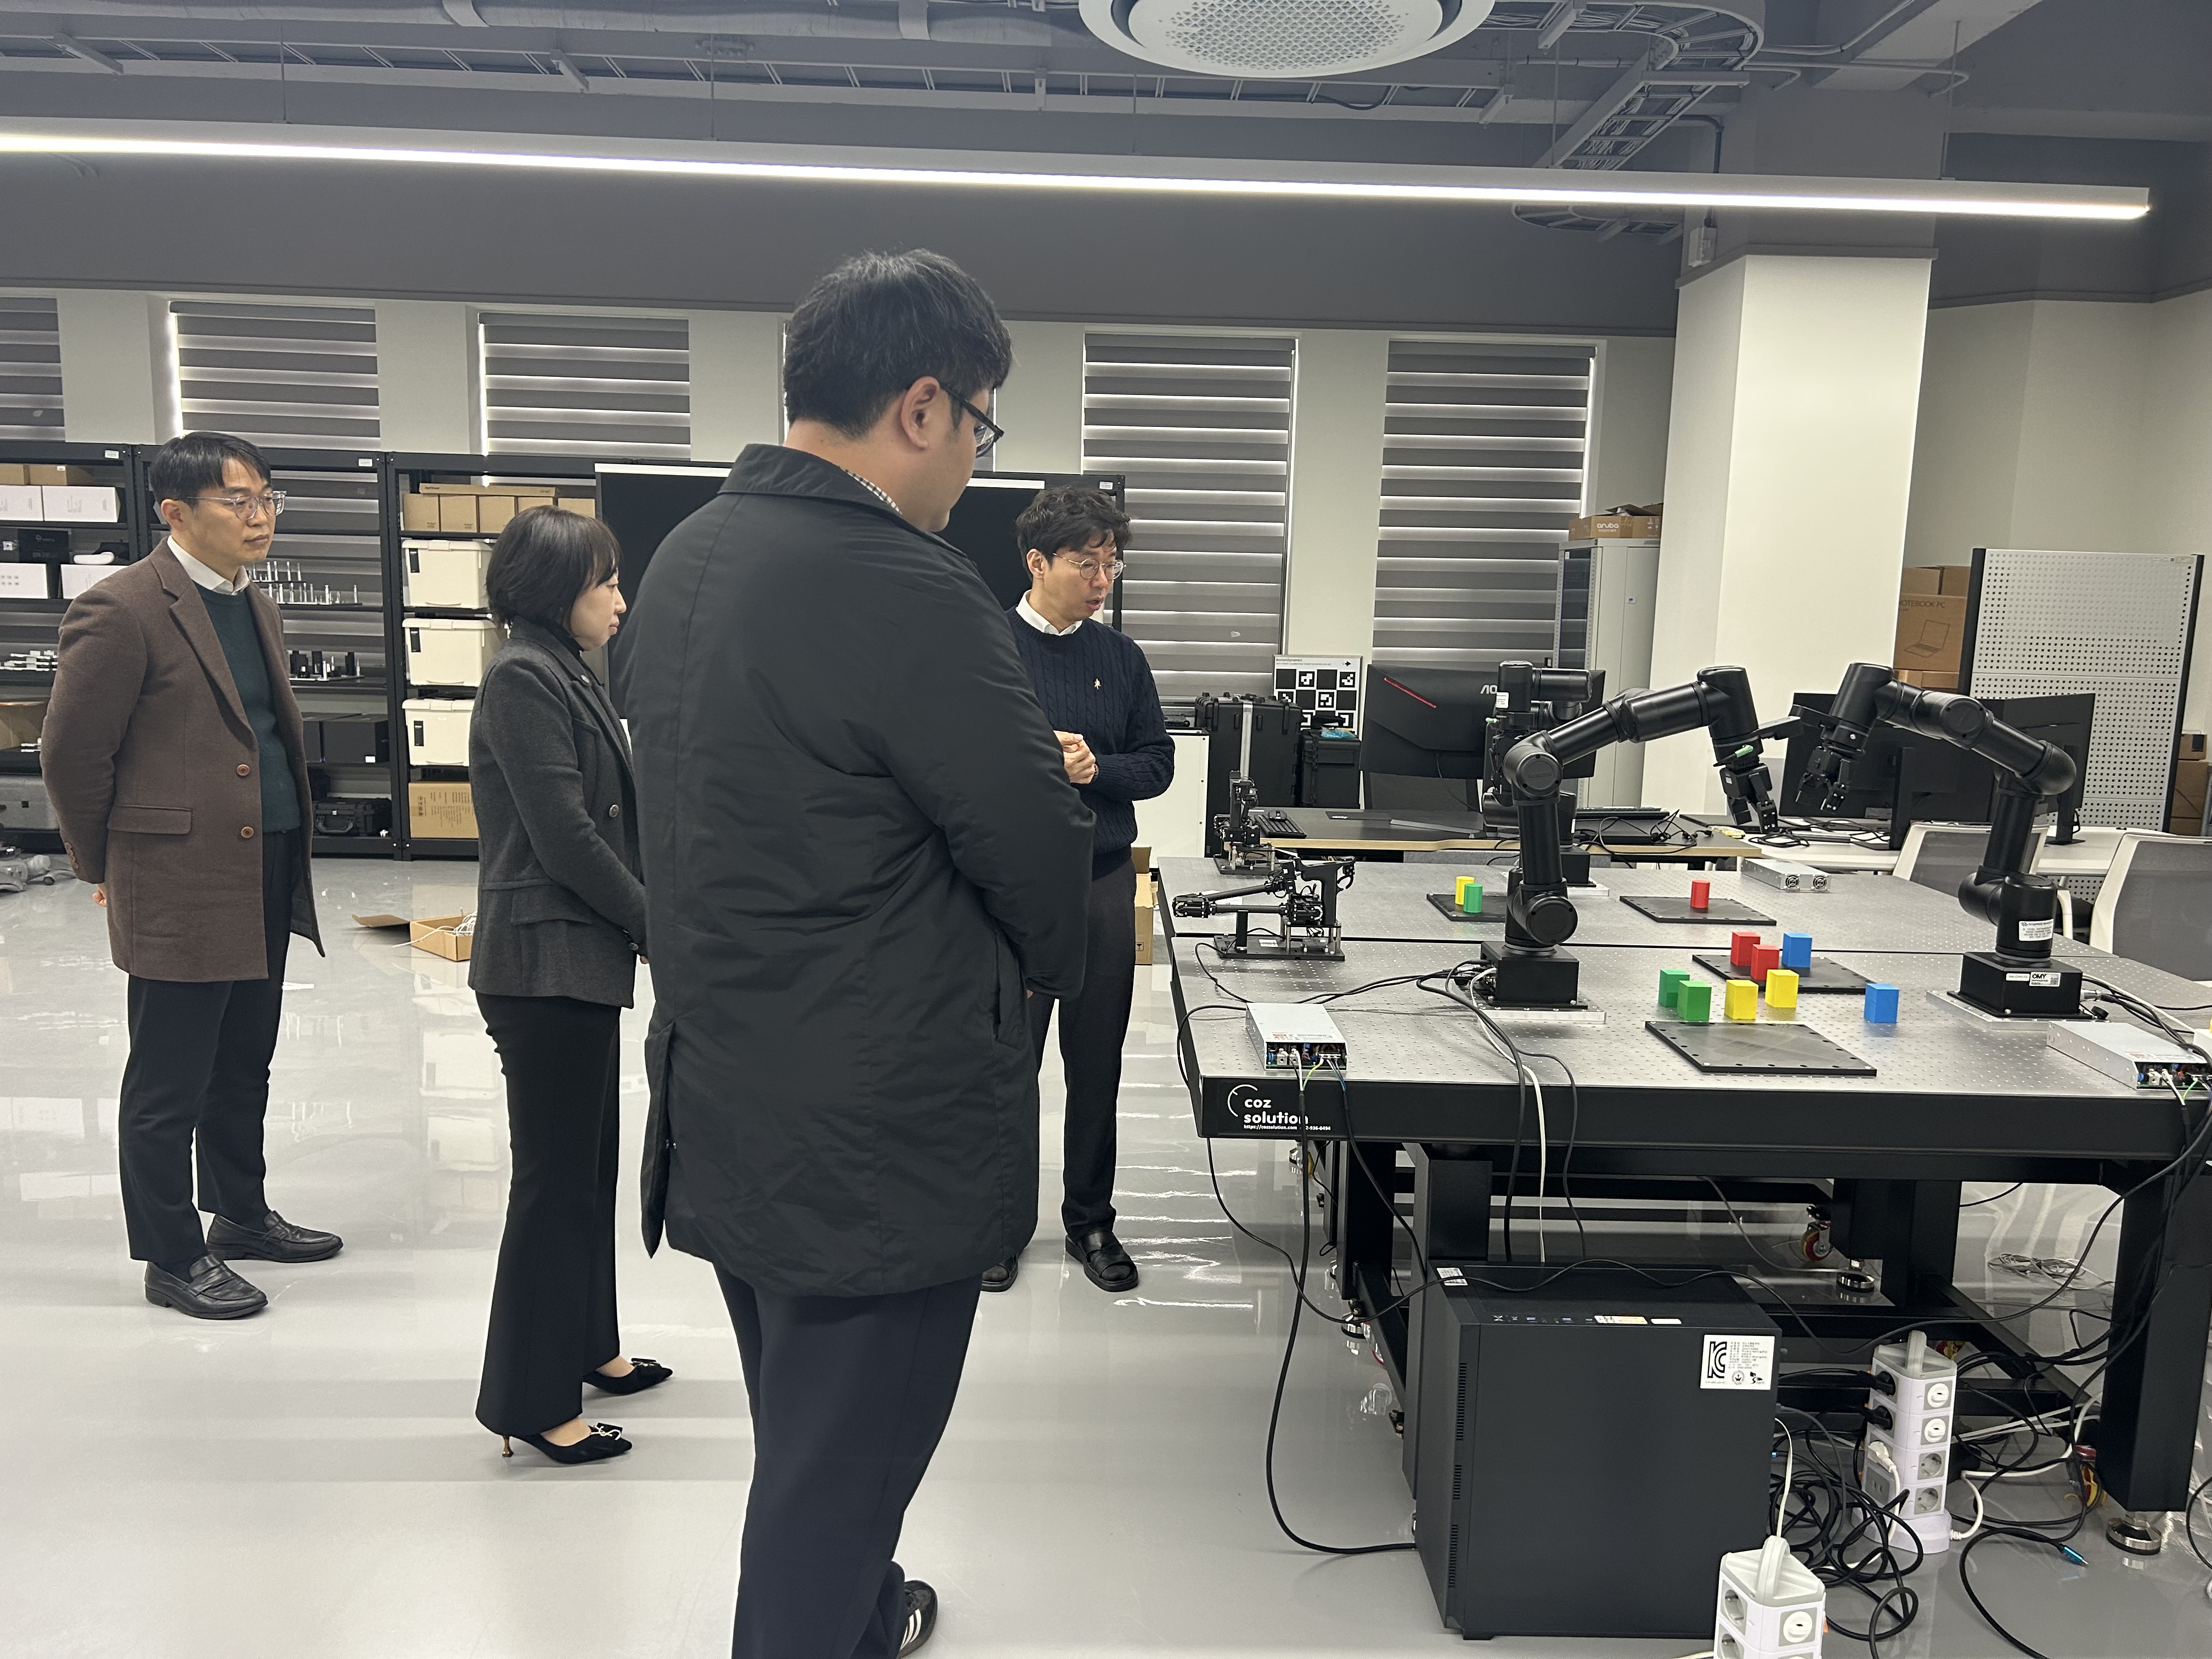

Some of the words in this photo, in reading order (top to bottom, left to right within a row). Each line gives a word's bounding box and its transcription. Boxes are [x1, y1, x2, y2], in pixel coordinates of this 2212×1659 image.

[1900, 599, 1936, 607] OTEBOOK
[1244, 1099, 1272, 1108] coz
[1244, 1111, 1308, 1124] solution
